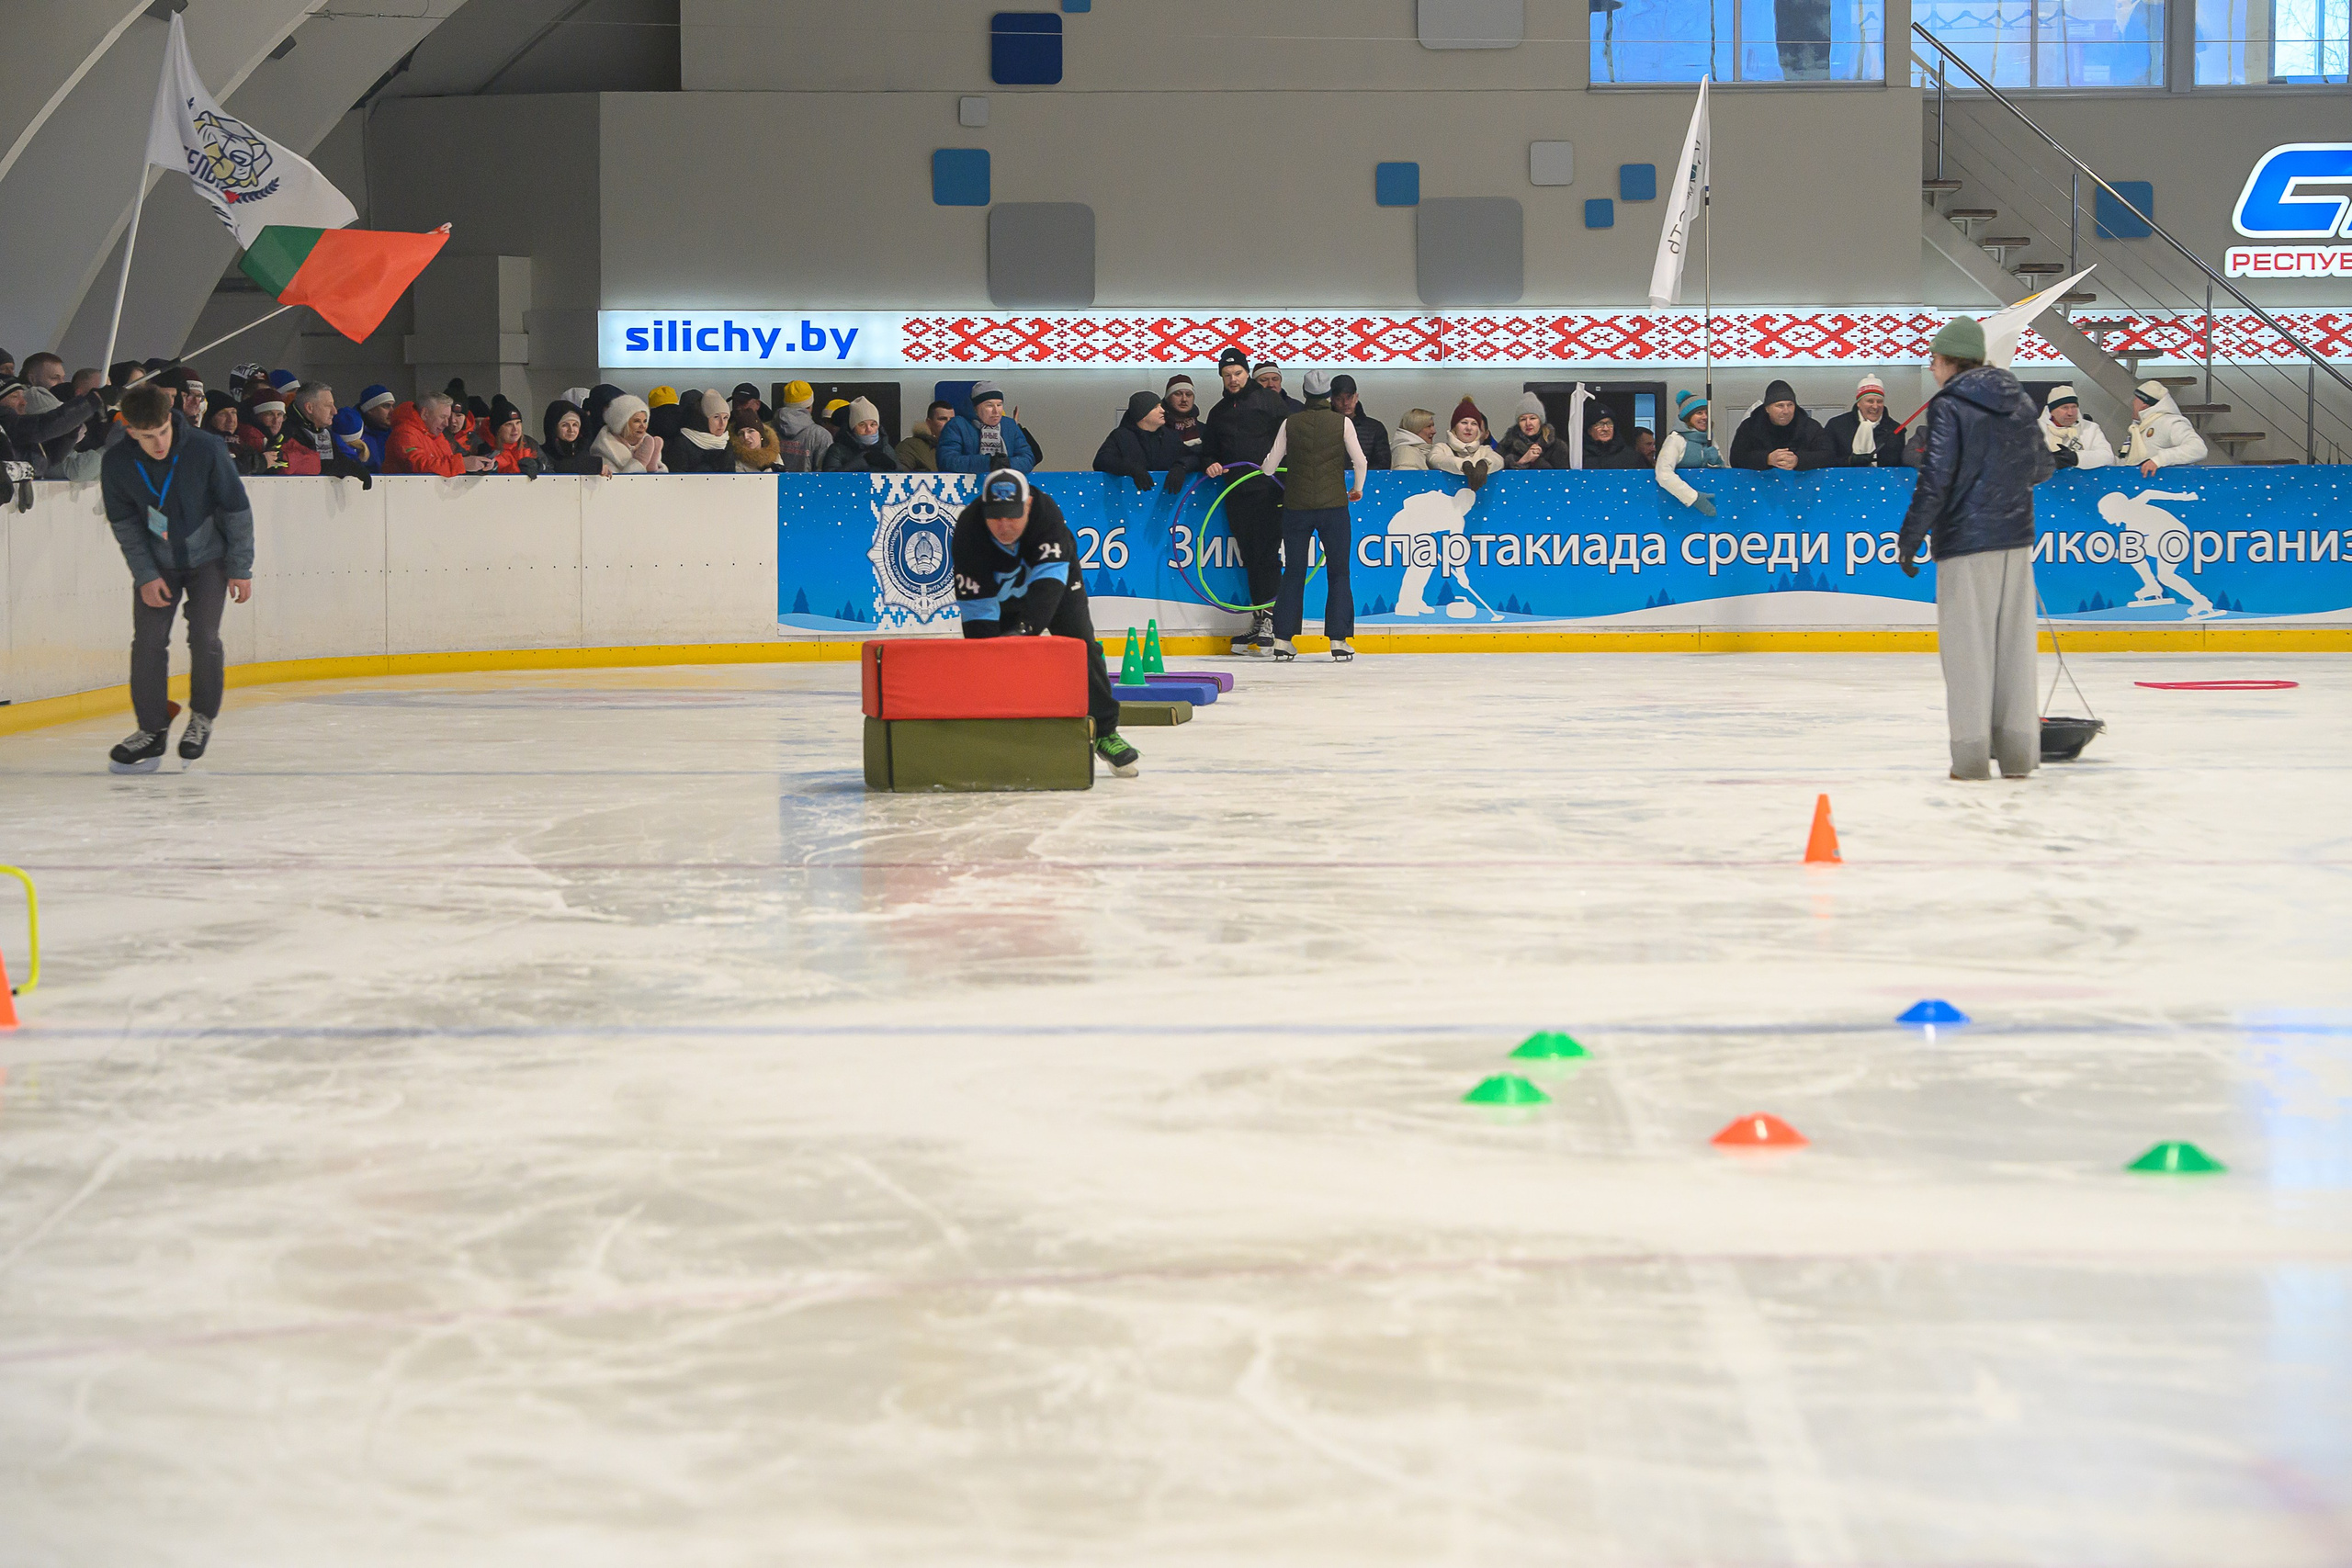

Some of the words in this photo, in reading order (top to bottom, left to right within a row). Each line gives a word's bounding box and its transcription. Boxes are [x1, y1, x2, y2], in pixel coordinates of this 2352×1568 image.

[626, 320, 858, 359] silichy.by
[1038, 542, 1062, 560] 24
[1357, 532, 1667, 577] спартакиада
[1680, 530, 1829, 576] среди
